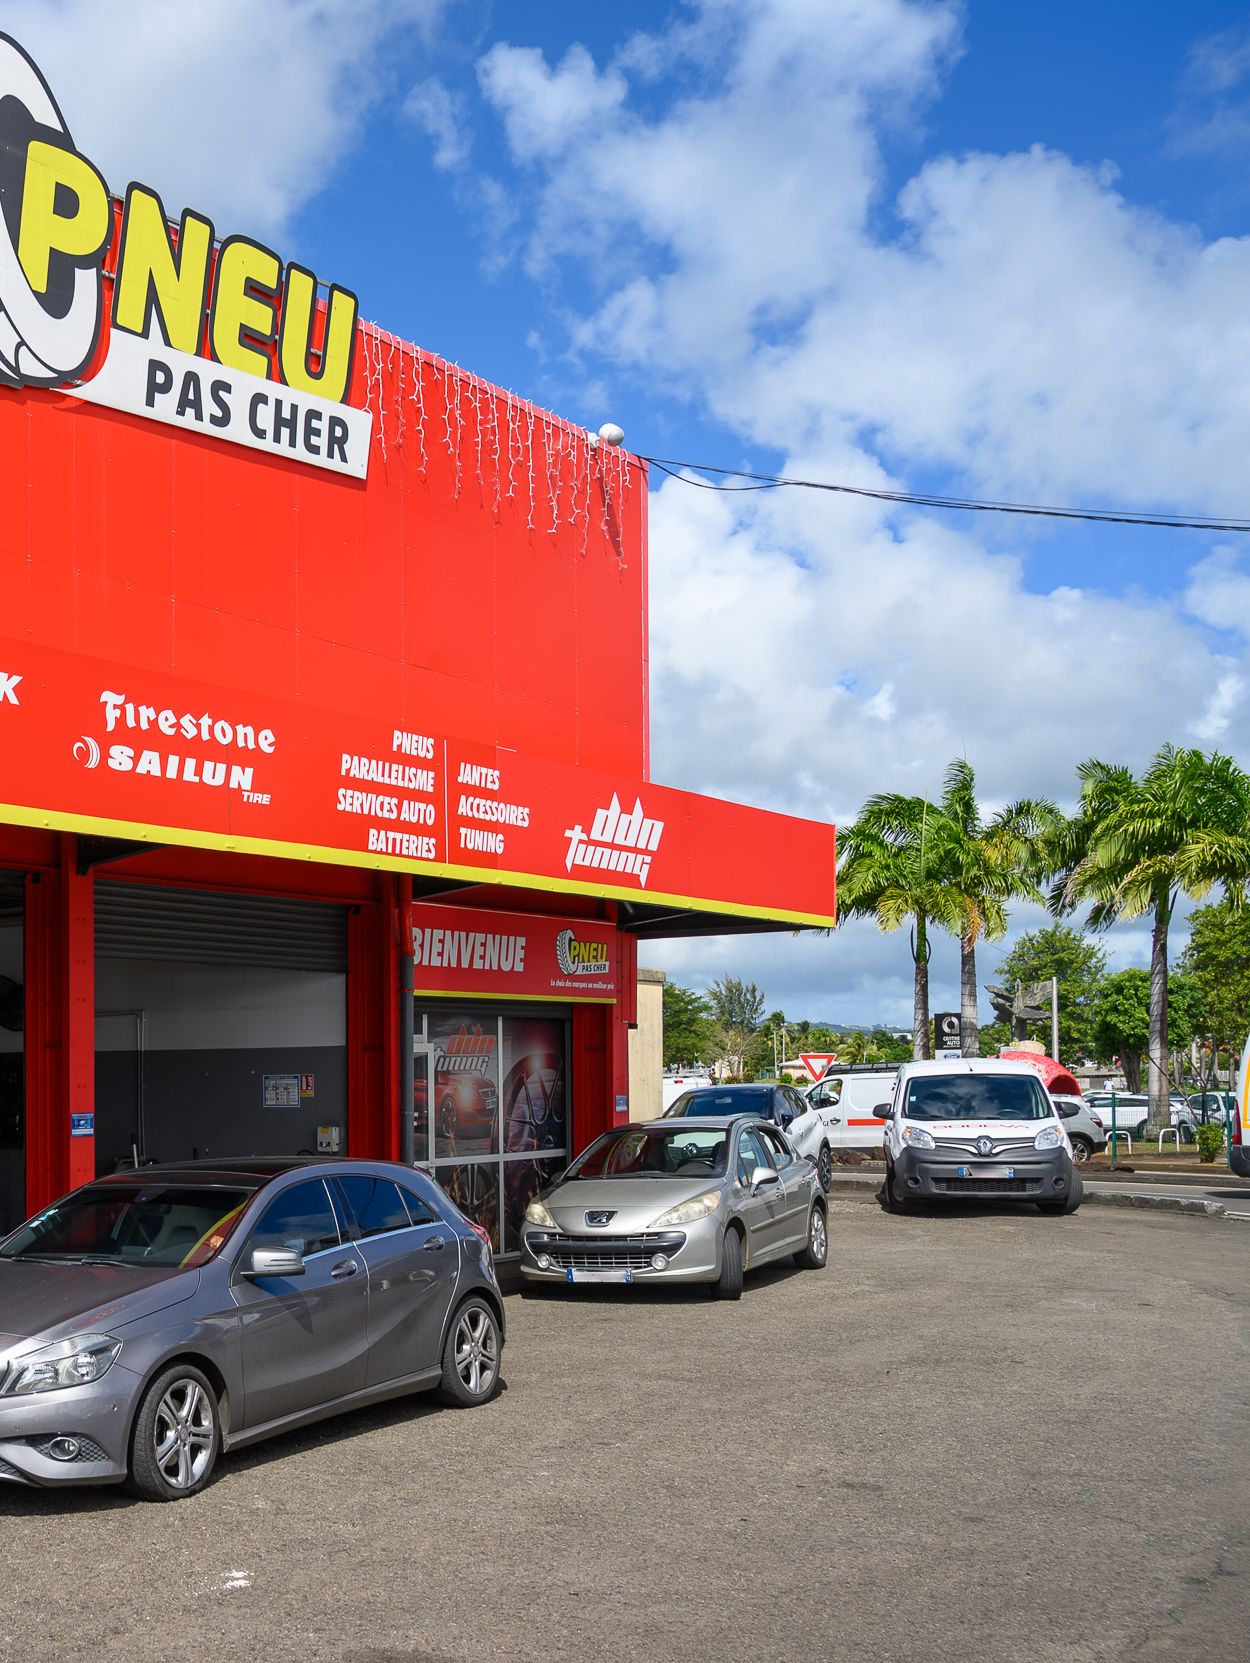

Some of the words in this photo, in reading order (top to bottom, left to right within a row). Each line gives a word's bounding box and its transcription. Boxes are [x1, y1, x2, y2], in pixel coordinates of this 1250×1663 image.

[13, 136, 359, 406] PNEU
[145, 358, 232, 428] PAS
[248, 392, 349, 464] CHER
[99, 690, 276, 754] Firestone
[392, 729, 435, 760] PNEUS
[107, 744, 254, 791] SAILUN
[340, 753, 435, 793] PARALLELISME
[457, 761, 500, 791] JANTES
[241, 790, 271, 805] TIRE
[336, 787, 398, 820] SERVICES
[399, 799, 436, 826] AUTO
[457, 794, 530, 828] ACCESSOIRES
[367, 828, 436, 860] BATTERIES
[458, 827, 505, 855] TUNING
[411, 927, 527, 972] BIENVENUE
[570, 940, 609, 963] PNEU
[581, 964, 592, 973] PAS
[593, 963, 607, 972] CHER
